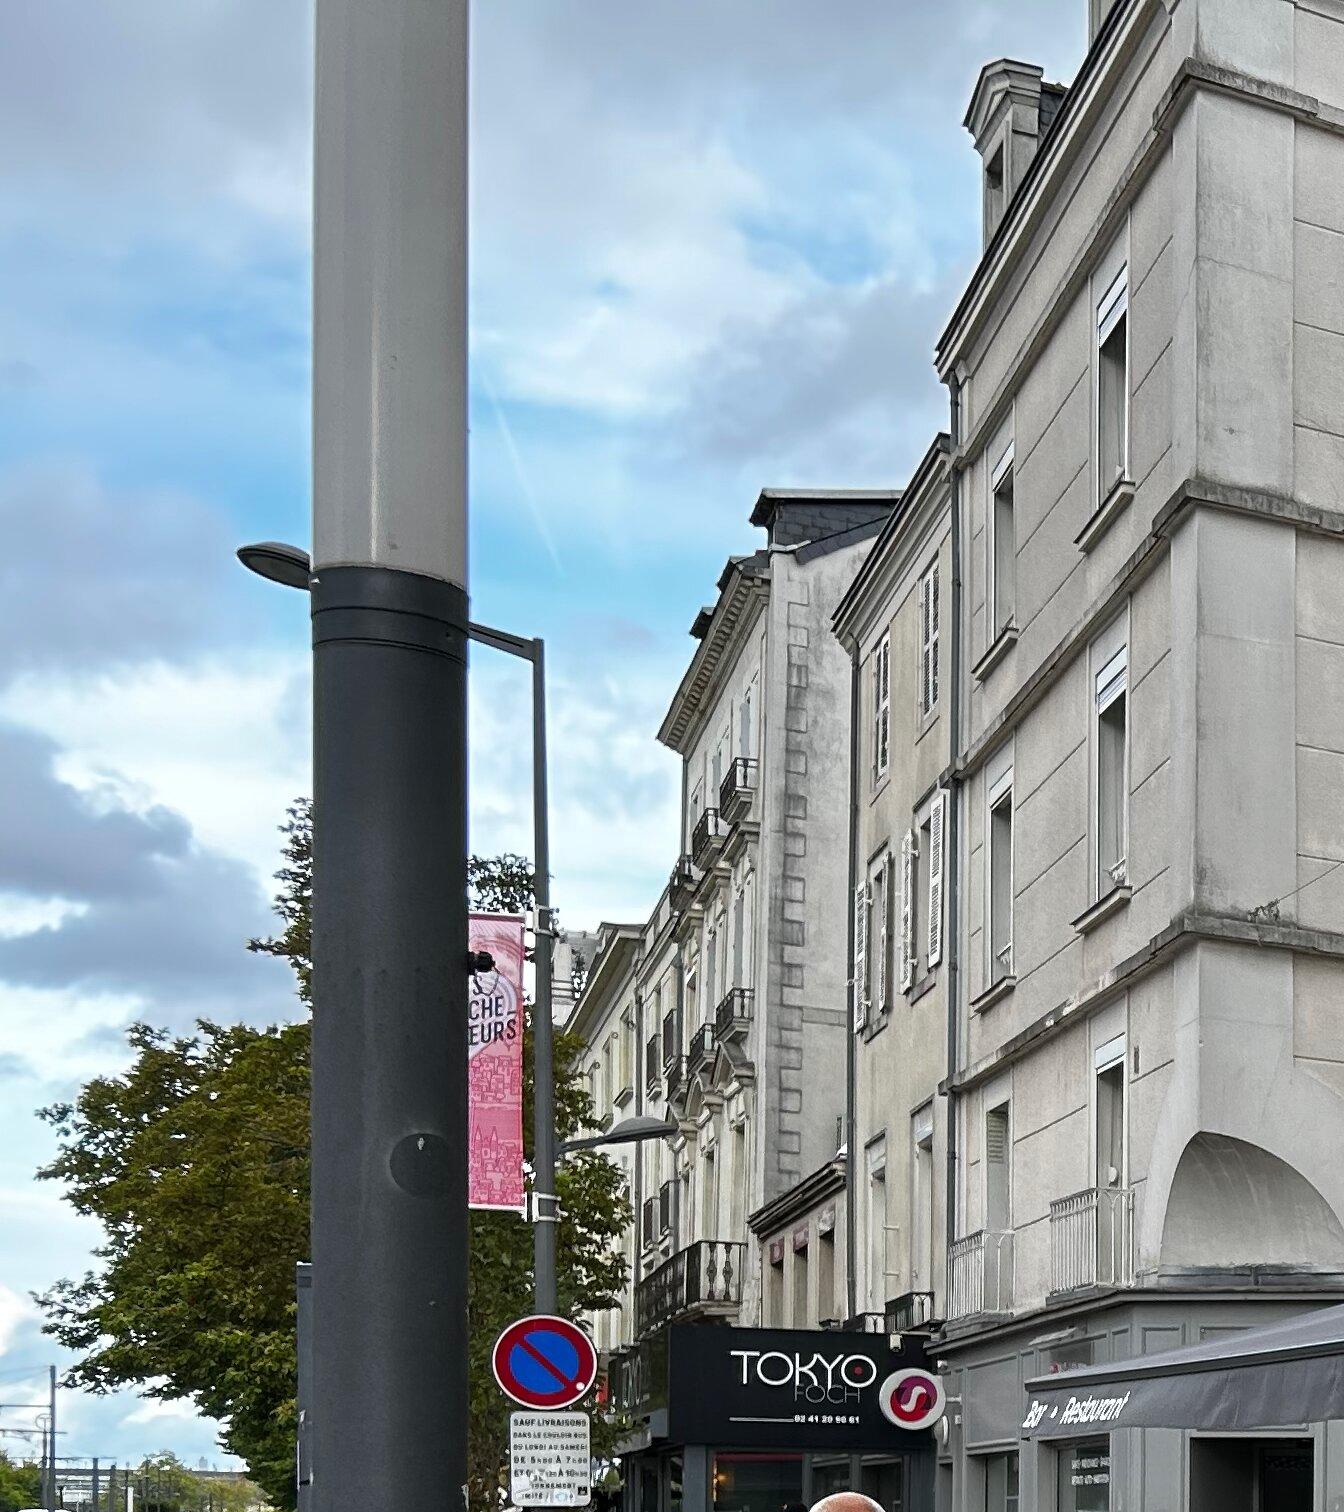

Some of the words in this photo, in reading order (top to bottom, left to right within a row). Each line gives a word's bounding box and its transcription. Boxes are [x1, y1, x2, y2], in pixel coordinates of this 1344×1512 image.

[729, 1350, 876, 1389] TOKYO
[794, 1383, 861, 1405] FOCH
[808, 1414, 819, 1423] 41
[1022, 1400, 1049, 1428] Bar
[1059, 1390, 1131, 1424] Restaurant
[513, 1418, 536, 1427] SAUF
[537, 1418, 588, 1427] LIVRAISONS
